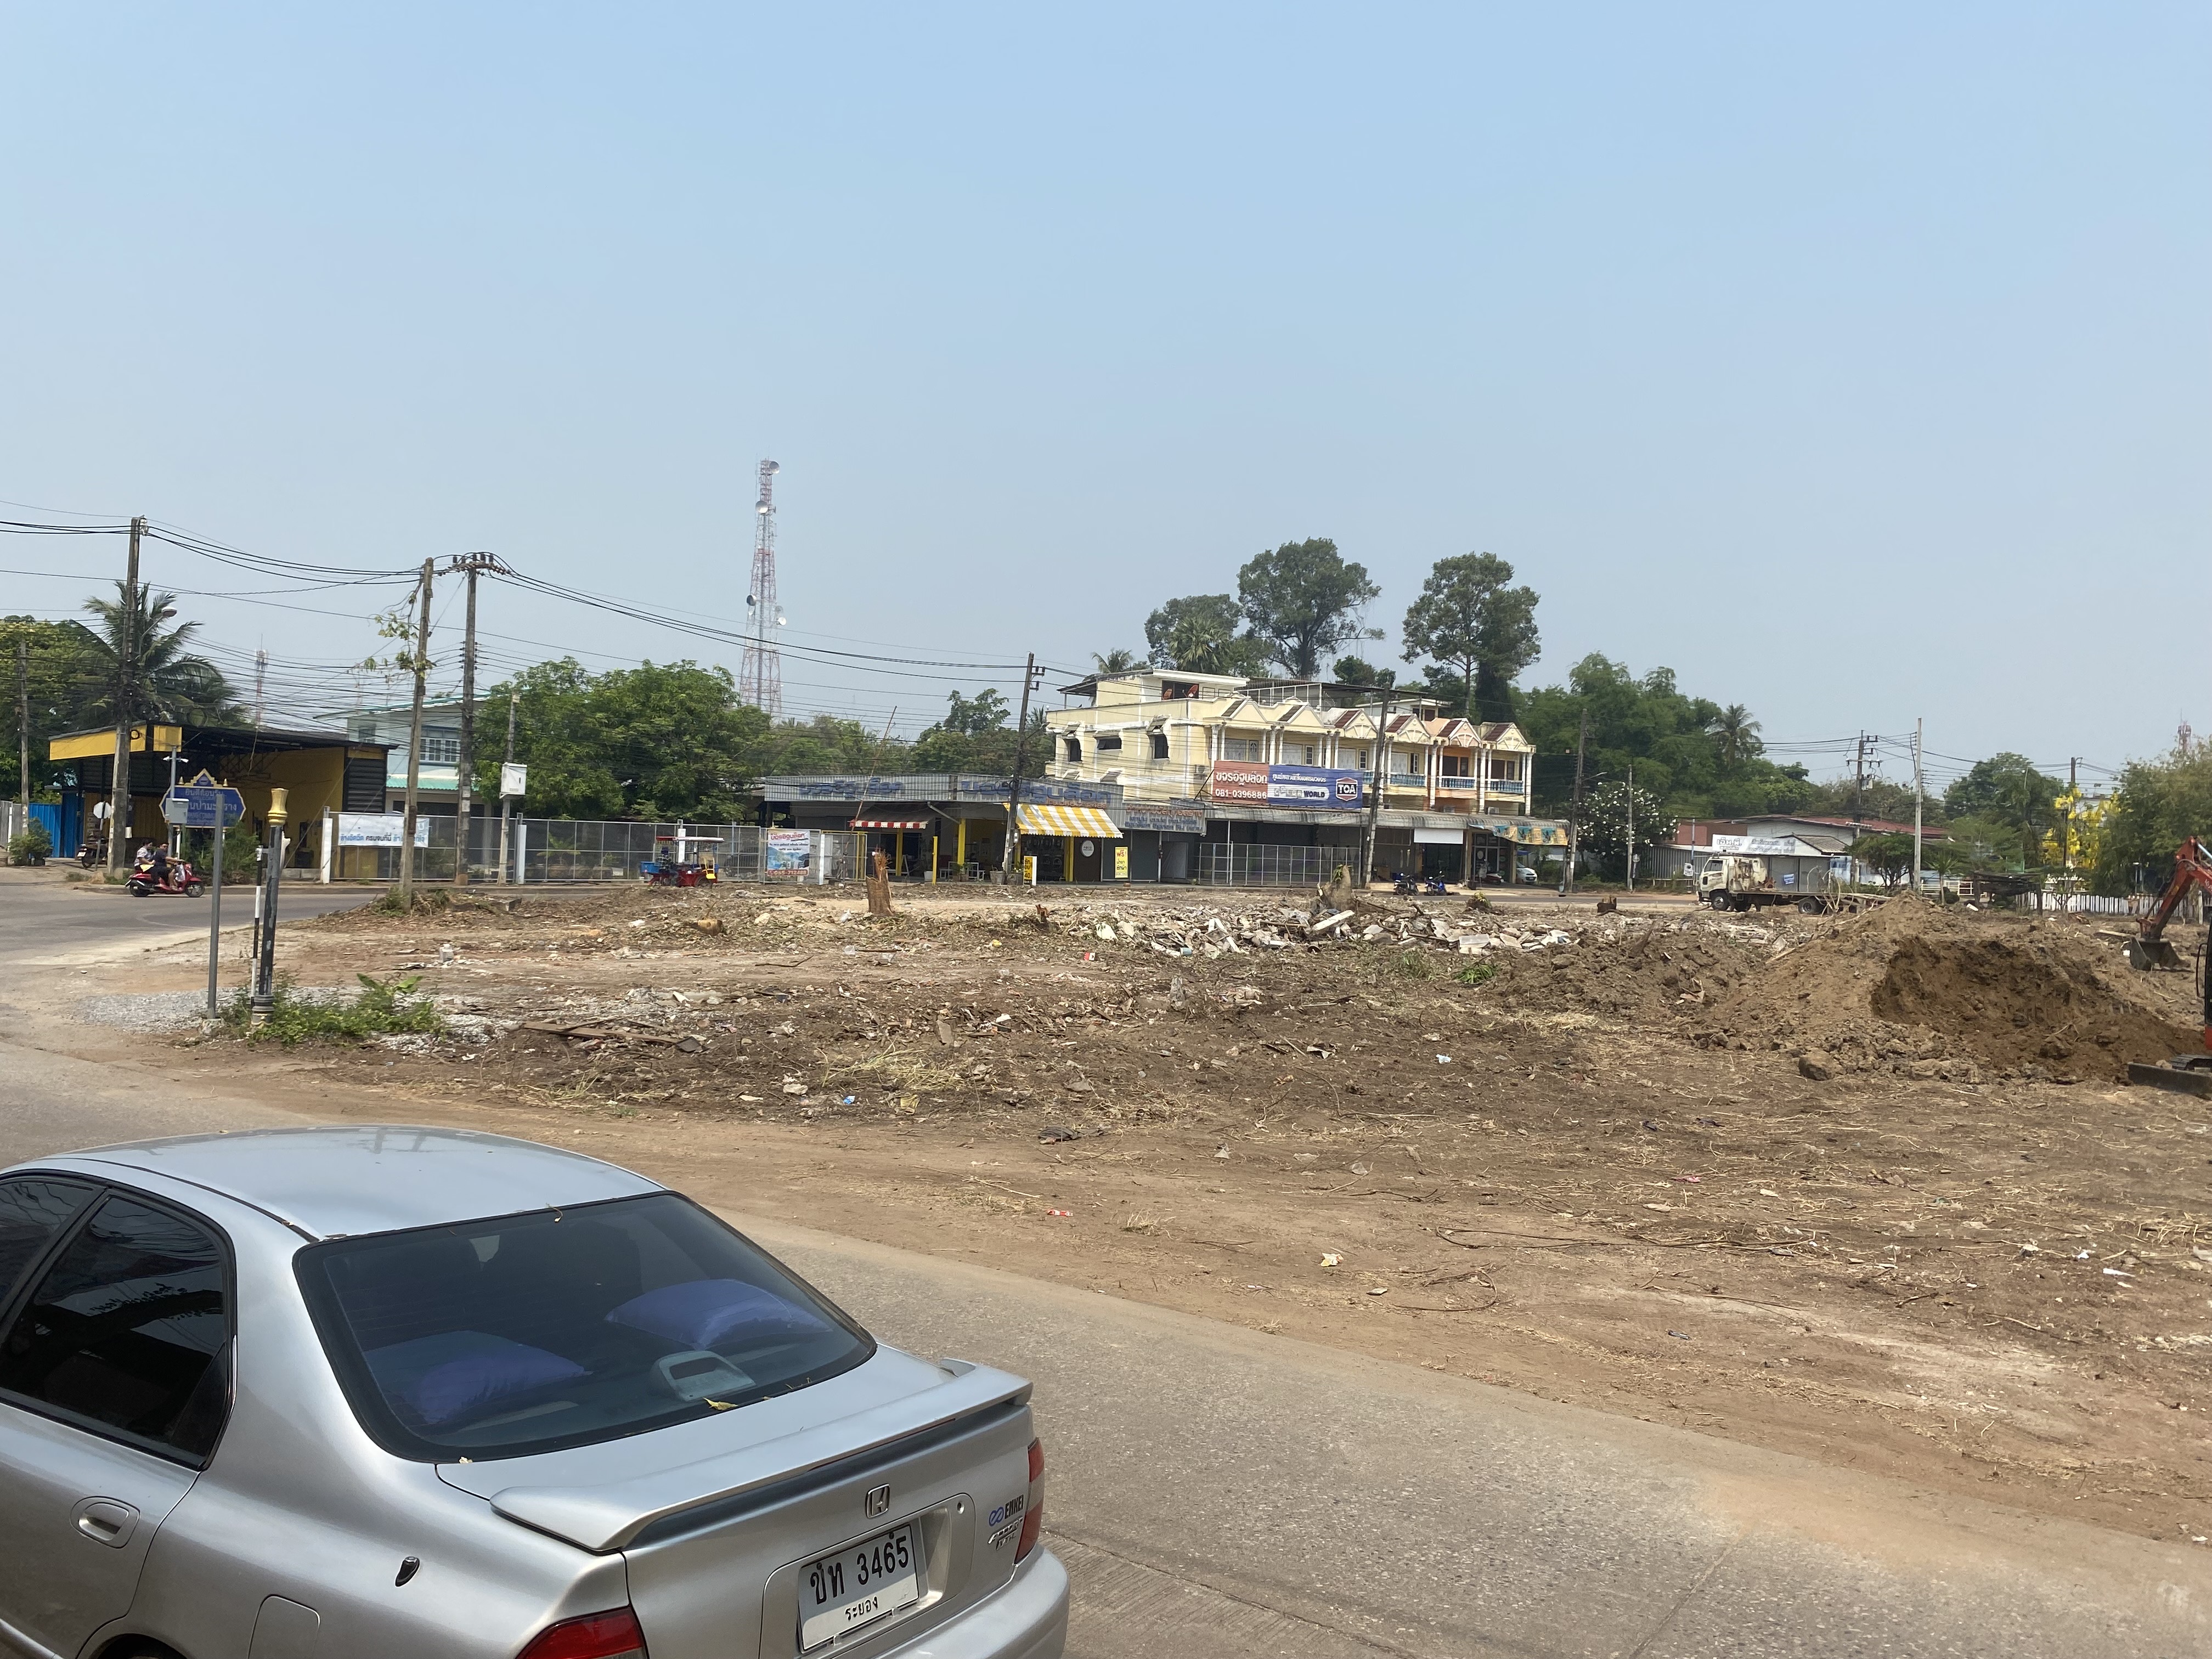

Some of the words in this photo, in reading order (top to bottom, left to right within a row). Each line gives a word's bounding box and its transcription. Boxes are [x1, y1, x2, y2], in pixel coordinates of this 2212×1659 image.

[1215, 788, 1267, 799] 081-0396886
[1338, 785, 1356, 794] TOA
[1005, 1494, 1024, 1519] ENKEI
[810, 1562, 845, 1605] ขท
[857, 1536, 909, 1585] 3465
[845, 1596, 879, 1621] ระยอง
